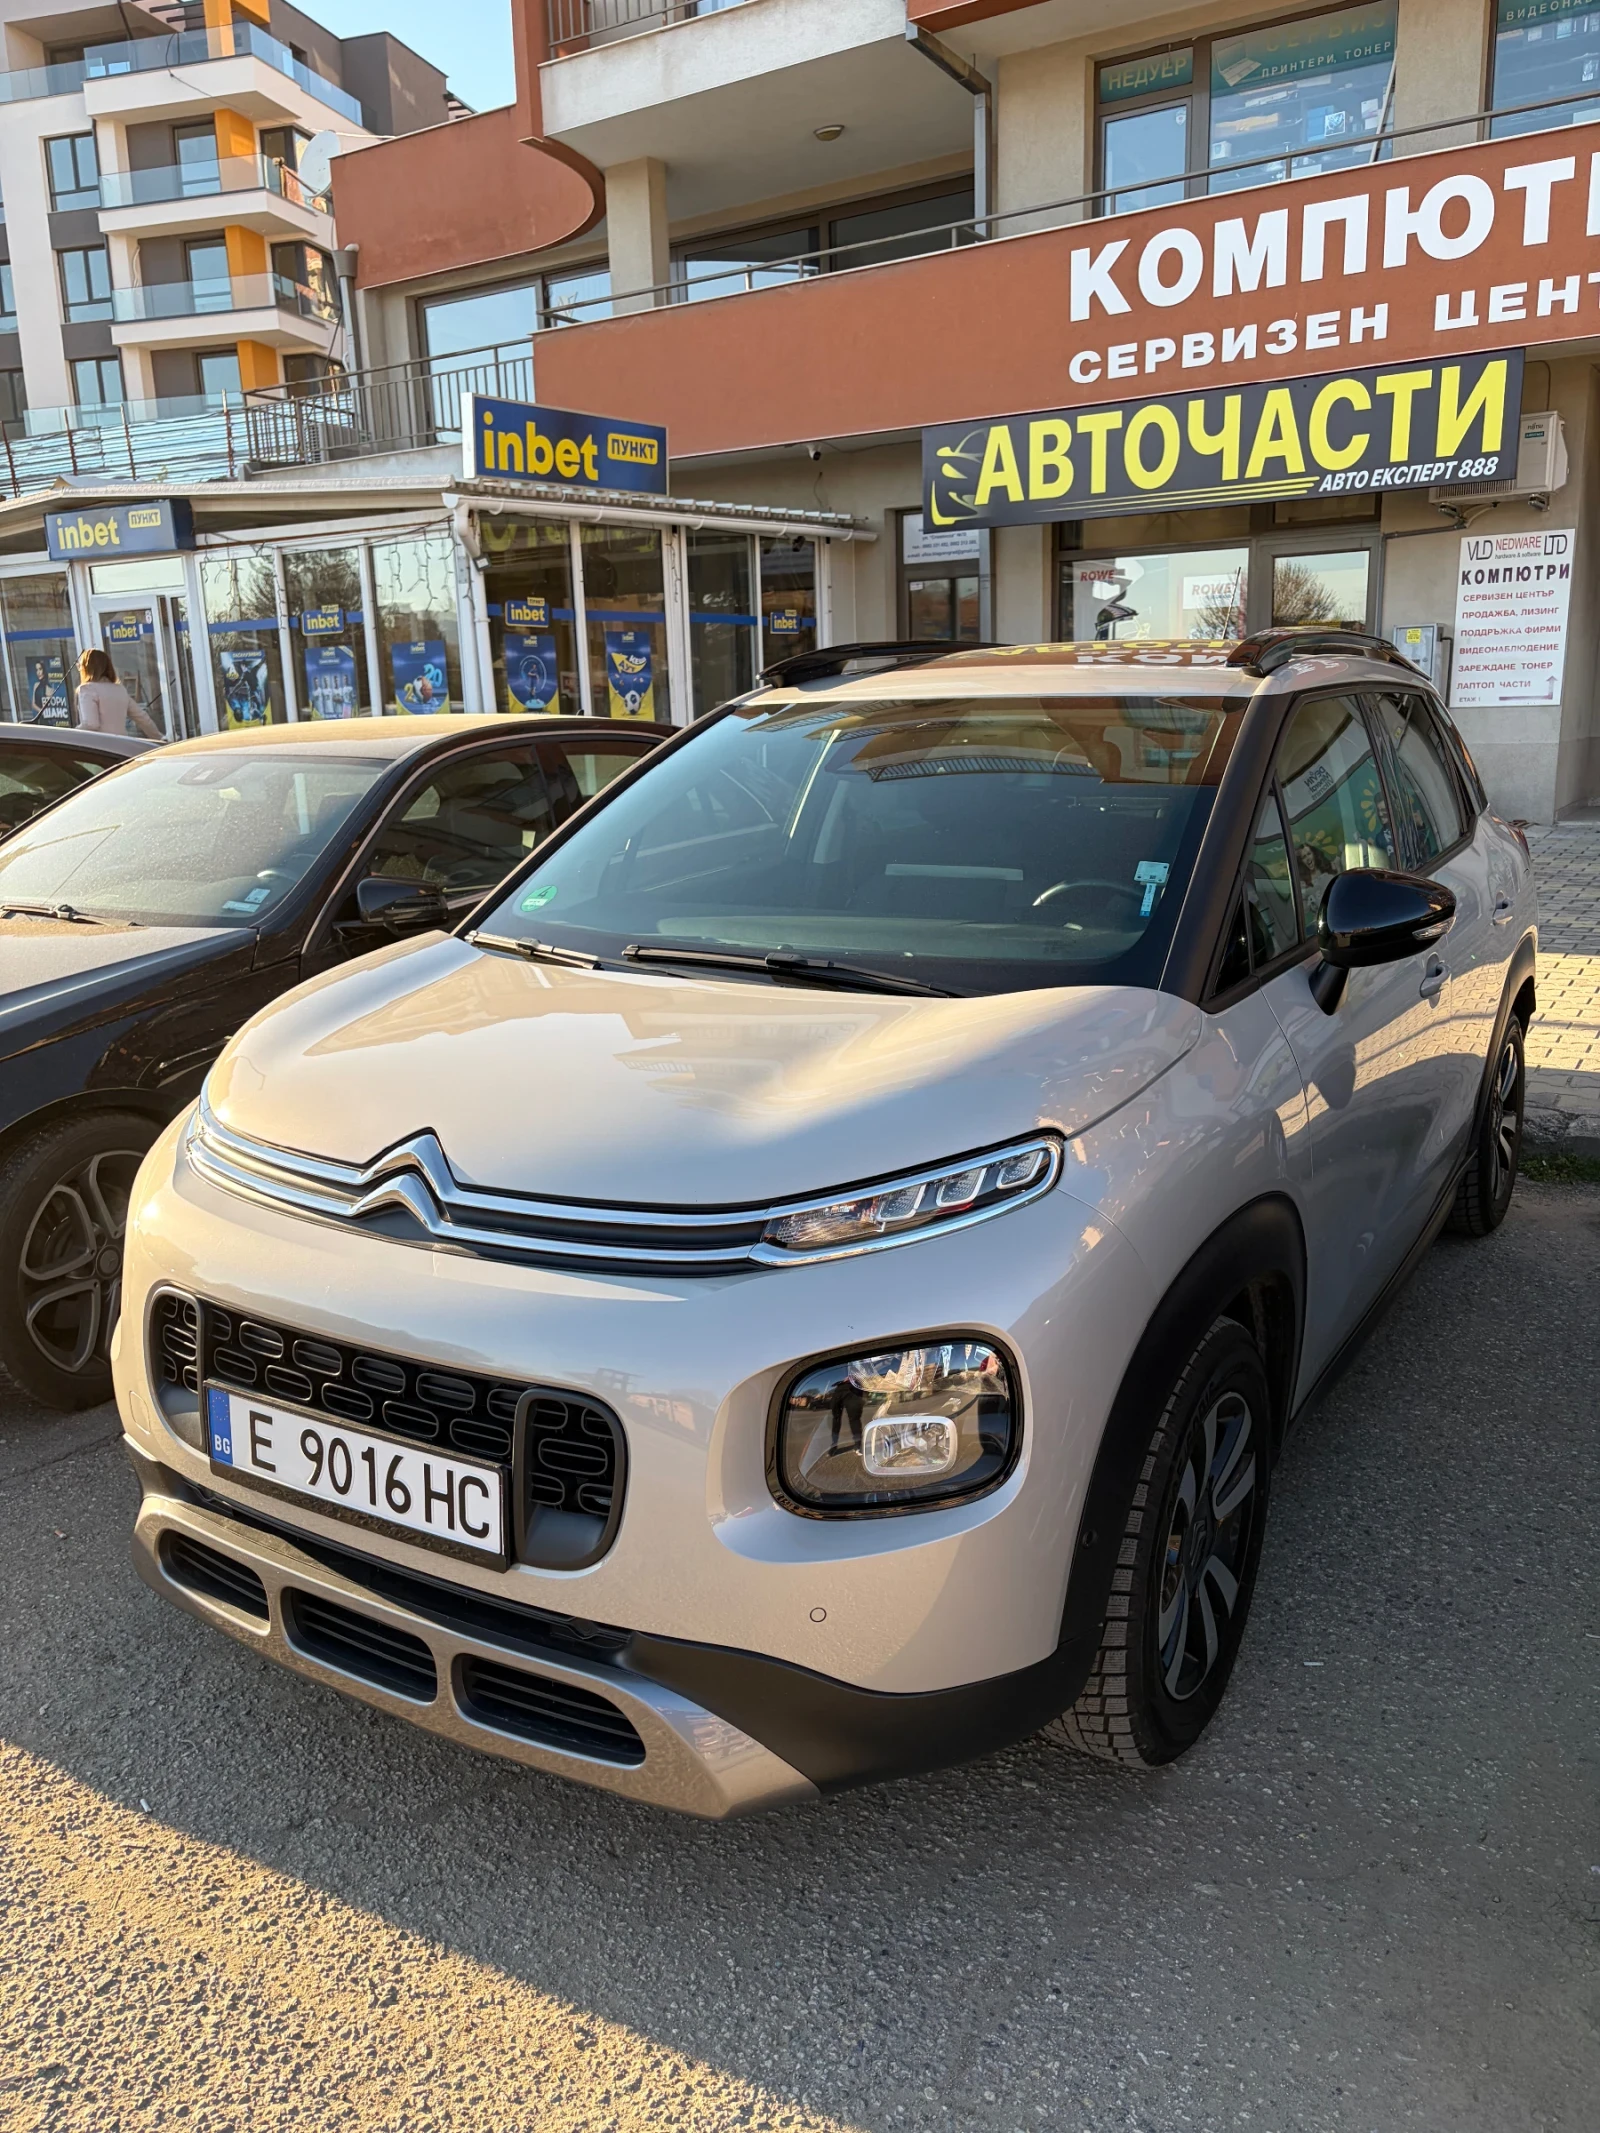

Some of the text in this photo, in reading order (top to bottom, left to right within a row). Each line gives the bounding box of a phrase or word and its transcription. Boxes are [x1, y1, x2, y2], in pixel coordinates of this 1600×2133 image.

[1261, 41, 1392, 79] ПРИНТЕРИ, ТОНЕР
[1108, 57, 1187, 91] НЕДУЕР
[1070, 152, 1600, 322] КОМПЮТ
[1068, 303, 1389, 384] СЕРВИЗЕН
[974, 360, 1508, 505] АВТОЧАСТИ
[483, 410, 599, 481] inbet
[610, 437, 656, 461] ПУНКТ
[1318, 456, 1498, 493] АВТО ЕКСПЕРТ 888
[129, 511, 161, 527] ПУНКТ
[57, 516, 121, 550] inbet
[1495, 535, 1542, 551] NEDWARE
[1544, 534, 1568, 556] LTD
[1080, 569, 1115, 582] ROWE
[1461, 563, 1570, 586] КОМПЮТРИ
[1192, 583, 1233, 596] ROWE
[1463, 589, 1555, 602] СЕРВИЗЕН ЦЕНТЪР
[510, 603, 545, 621] inbet
[1461, 607, 1560, 620] ПРОДАЖБА, ЛИЗИНГ
[306, 614, 340, 630] inbet
[773, 614, 797, 629] inbet
[112, 625, 138, 639] inbet
[1460, 625, 1561, 637] ПОДДРЪЖКА ФИРМИ
[1459, 643, 1560, 655] ВИДЕОНАБЛЮДЕНИЕ
[1458, 661, 1553, 672] ЗАРЕЖДАНЕ ТОНЕР
[1456, 680, 1531, 690] ЛАПТОП ЧАСТИ
[43, 707, 69, 719] ШАНС
[214, 1434, 231, 1454] BG
